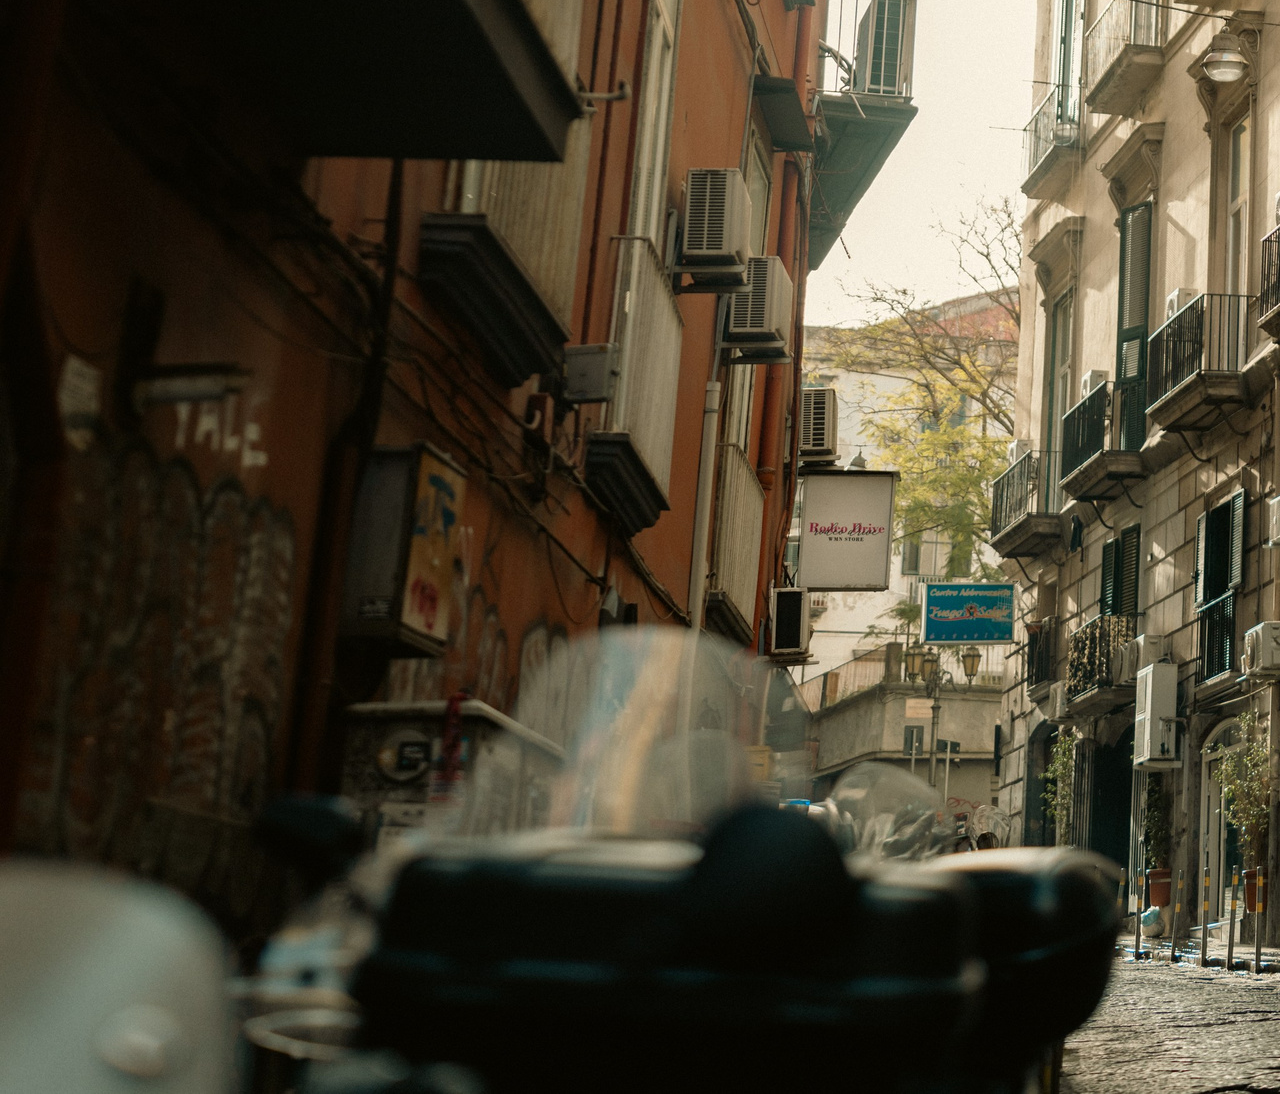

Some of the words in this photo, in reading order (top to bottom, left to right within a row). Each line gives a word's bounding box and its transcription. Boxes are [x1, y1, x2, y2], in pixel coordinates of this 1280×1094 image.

[809, 522, 848, 534] Rodeo
[852, 522, 885, 534] Drive
[930, 588, 958, 597] Centro
